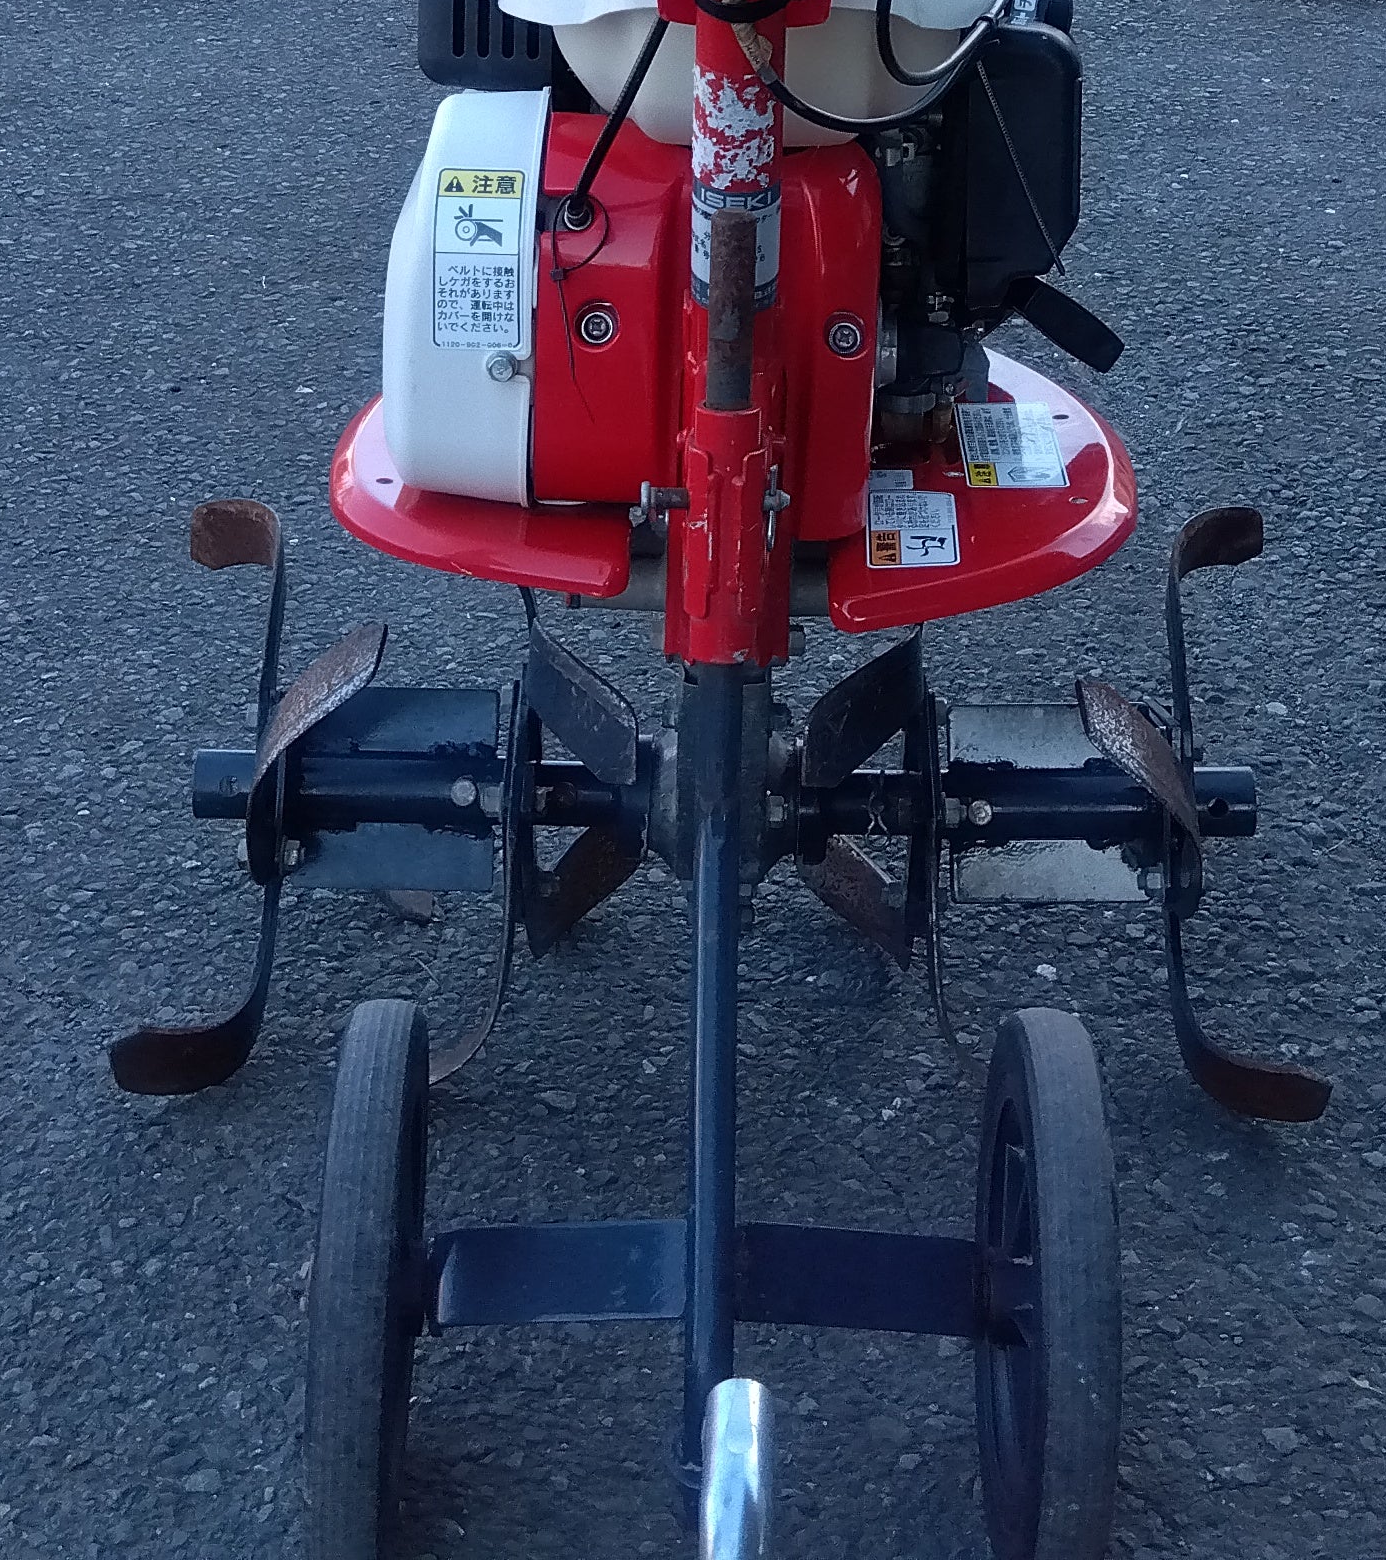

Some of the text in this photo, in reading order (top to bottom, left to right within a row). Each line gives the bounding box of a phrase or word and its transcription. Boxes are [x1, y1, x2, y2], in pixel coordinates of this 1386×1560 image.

[471, 175, 517, 194] 注意
[700, 187, 772, 210] ISEKI
[447, 265, 515, 277] ベルトに接触
[438, 276, 515, 289] しケガをするお
[437, 287, 515, 300] それがあります
[437, 299, 515, 311] ので、運転中は
[437, 310, 515, 322] カバーを開けな
[437, 322, 509, 334] いでください。
